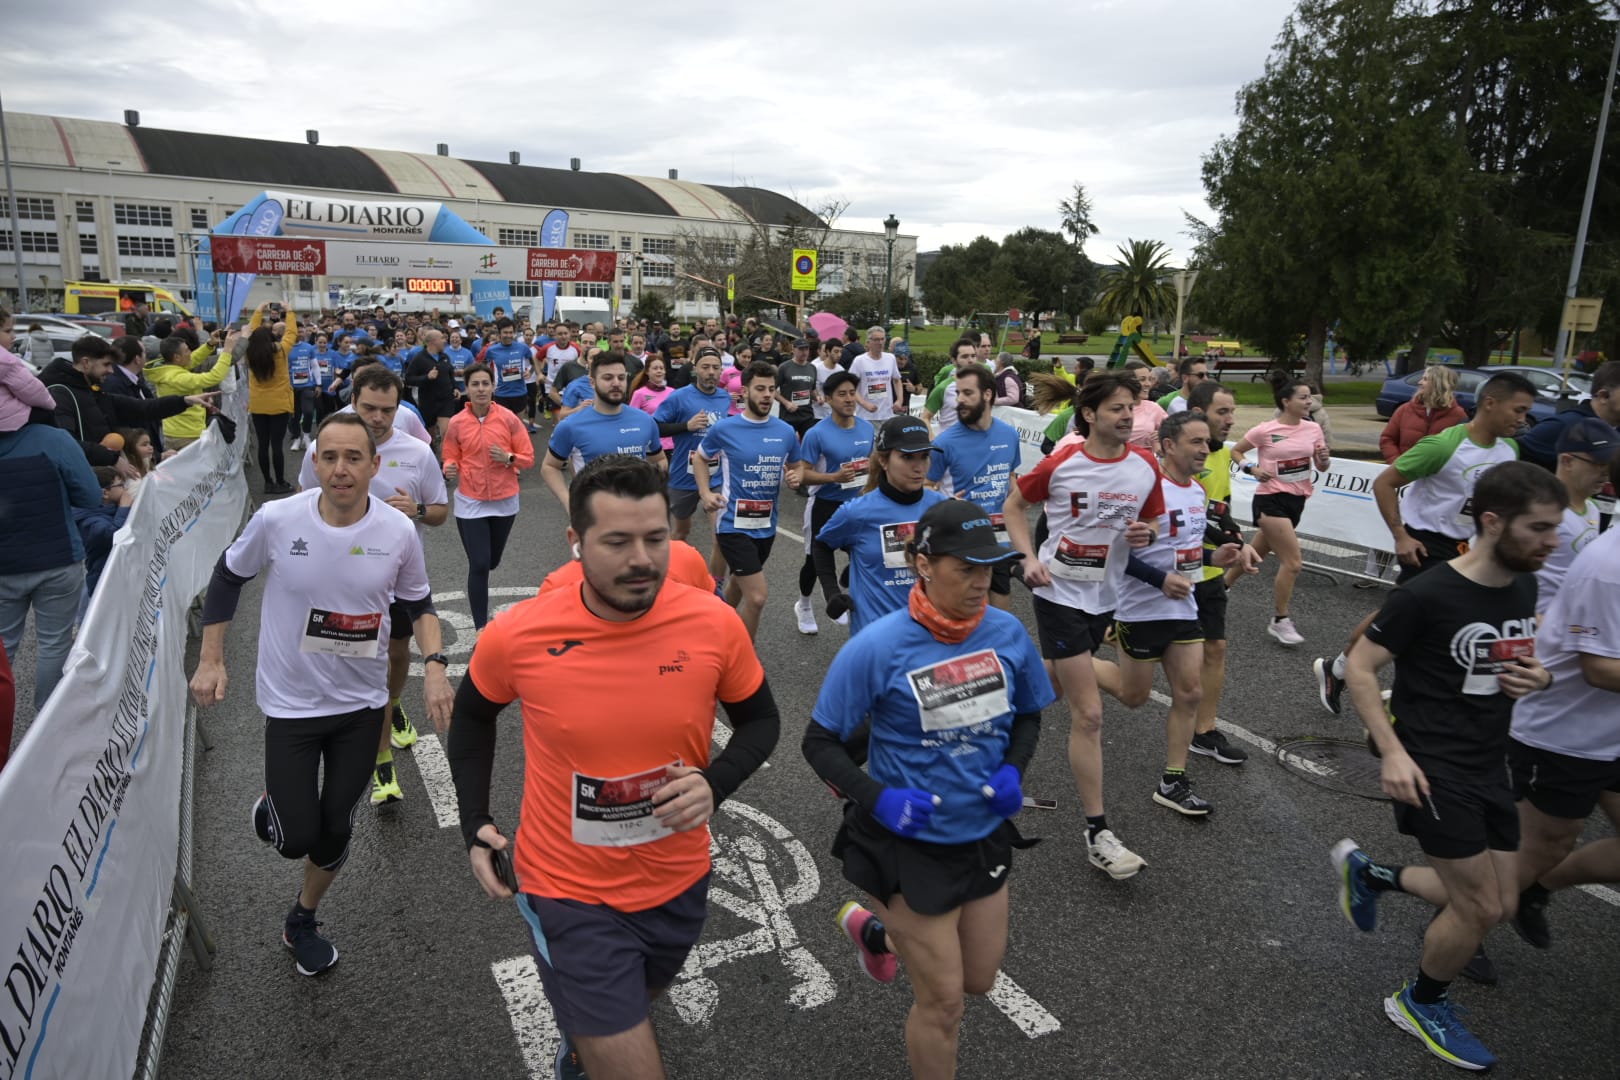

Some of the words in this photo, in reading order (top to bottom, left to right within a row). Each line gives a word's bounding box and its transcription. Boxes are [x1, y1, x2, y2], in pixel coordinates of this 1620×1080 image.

[286, 198, 321, 222] EL
[327, 202, 424, 227] DIARIO
[373, 226, 423, 235] MONTAÑÉS
[256, 249, 291, 260] CARRERA
[293, 250, 303, 261] DE
[355, 255, 368, 263] EL
[368, 255, 400, 264] DIARIO
[257, 260, 273, 271] LAS
[274, 261, 315, 272] EMPRESAS
[531, 258, 559, 268] CARRERA
[560, 259, 569, 269] DE
[531, 269, 543, 278] LAS
[544, 269, 577, 279] EMPRESAS
[1324, 472, 1345, 490] EL
[312, 613, 325, 624] 5K
[658, 663, 684, 676] pwc
[917, 675, 933, 691] 5K
[580, 783, 597, 799] 5K
[62, 818, 94, 883] EL
[78, 738, 125, 843] DIARIO
[4, 863, 74, 1031] DIARIO
[54, 905, 85, 980] MONTAÑÉS
